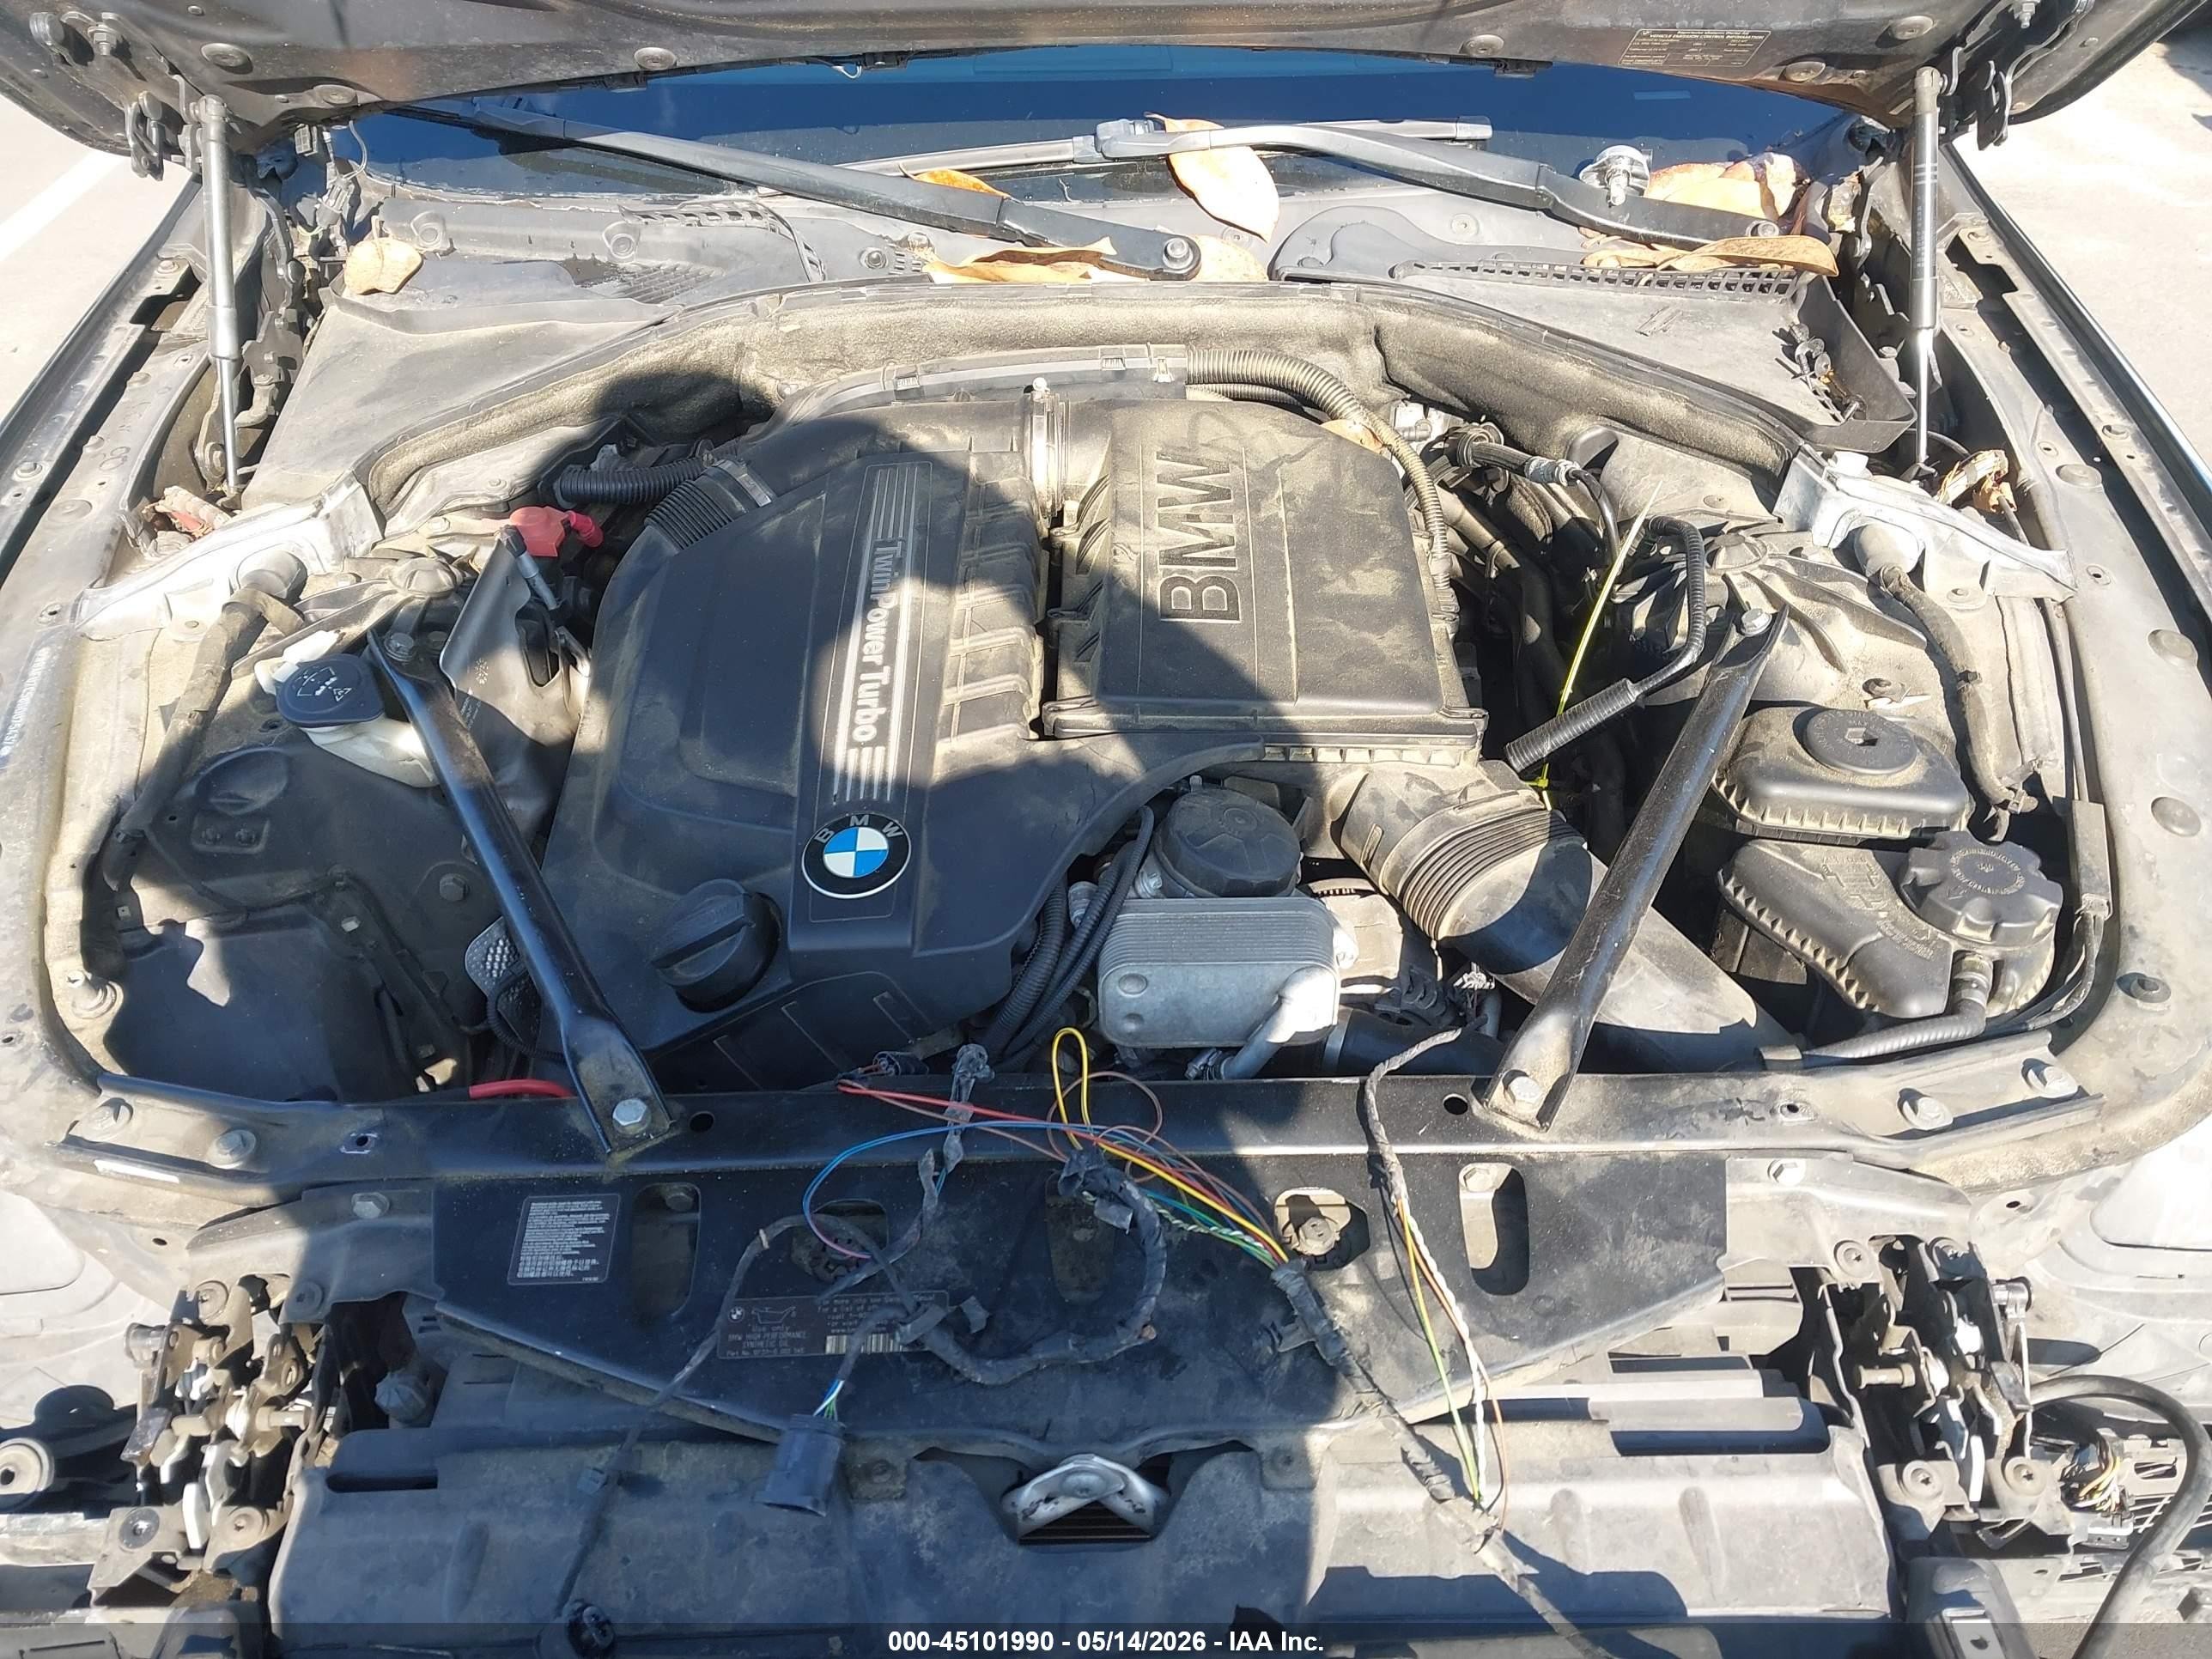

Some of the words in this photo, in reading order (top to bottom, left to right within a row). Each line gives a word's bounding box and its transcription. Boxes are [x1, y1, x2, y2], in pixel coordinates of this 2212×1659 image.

[1156, 451, 1242, 623] BMW
[862, 540, 904, 664] TwinPower
[853, 666, 890, 741] Turbo
[814, 815, 903, 844] BMW
